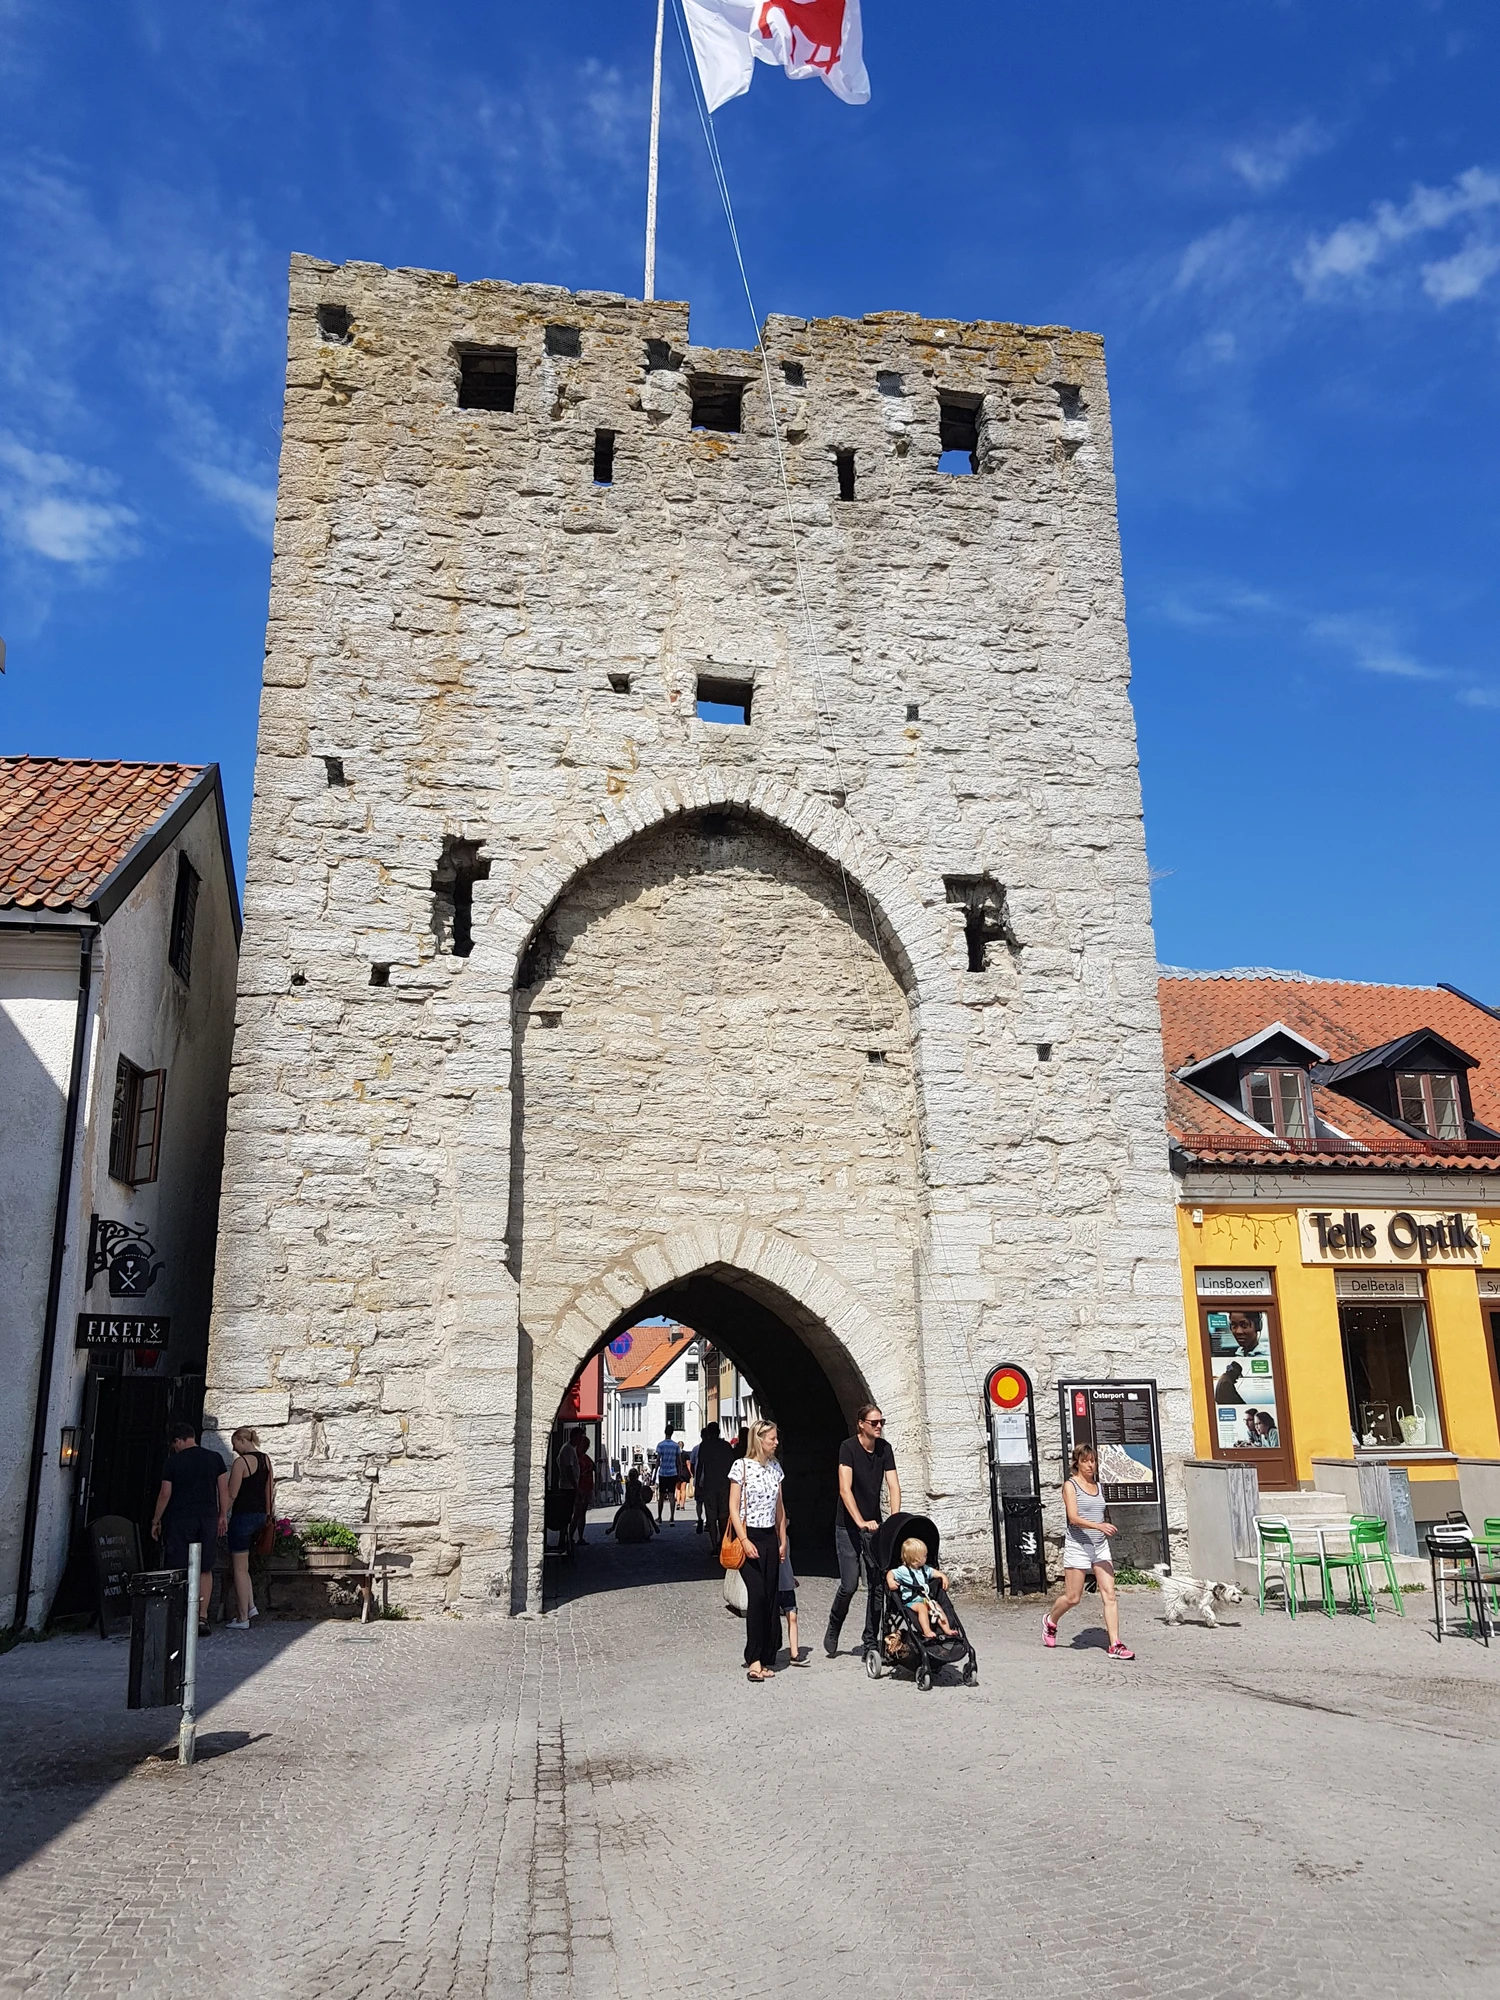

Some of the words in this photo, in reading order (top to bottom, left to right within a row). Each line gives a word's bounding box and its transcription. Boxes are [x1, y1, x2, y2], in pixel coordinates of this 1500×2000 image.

[1308, 1212, 1377, 1248] Tells
[1387, 1212, 1479, 1259] Optik
[1351, 1279, 1405, 1291] DelBetala
[1487, 1280, 1500, 1295] Sy
[87, 1321, 146, 1337] FIKET
[122, 1336, 141, 1344] BAR
[1093, 1390, 1125, 1400] Österport
